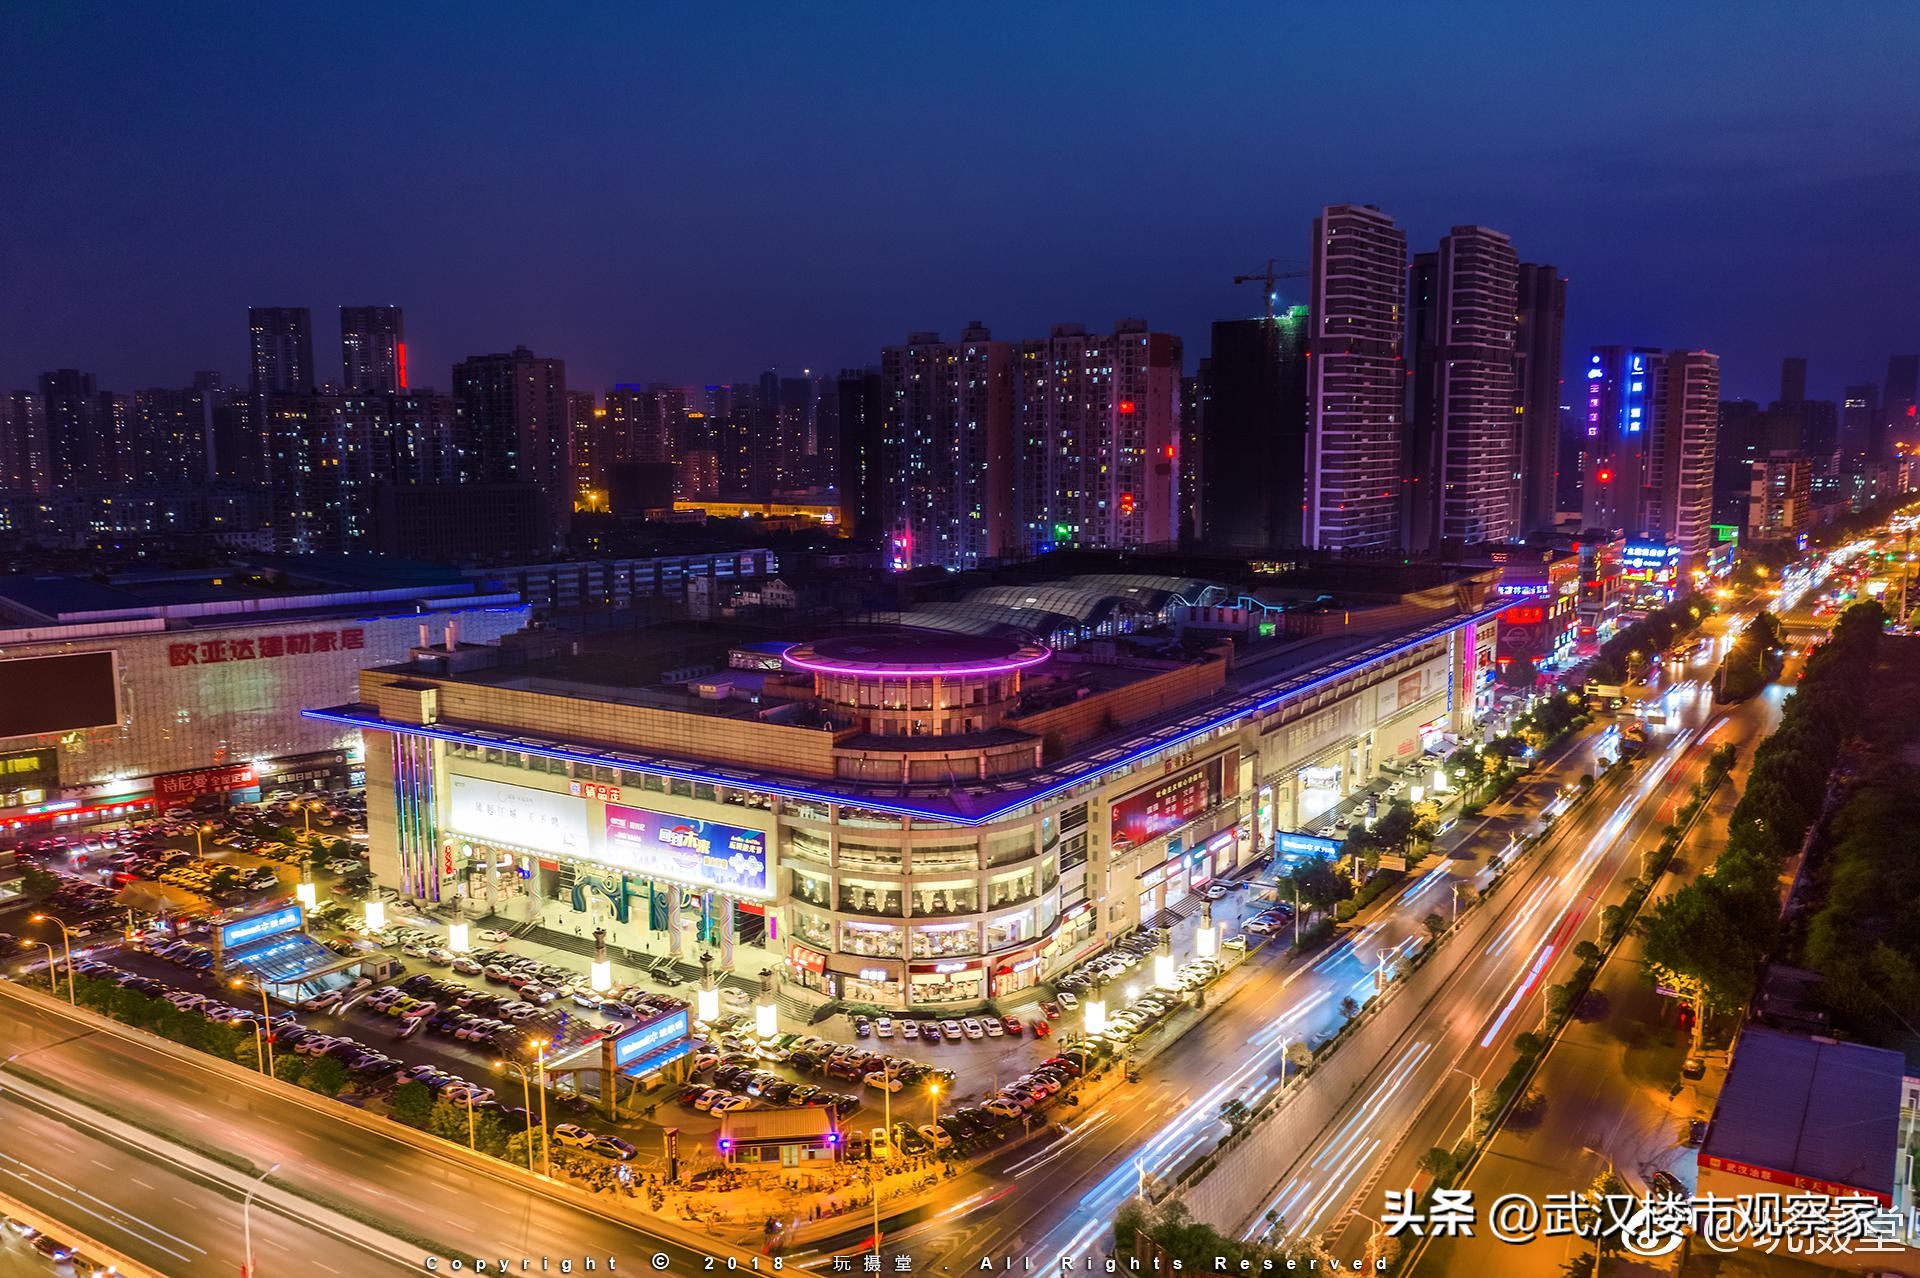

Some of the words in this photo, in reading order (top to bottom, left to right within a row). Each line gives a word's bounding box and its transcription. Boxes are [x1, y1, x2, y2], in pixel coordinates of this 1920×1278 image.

[168, 629, 365, 667] 欧亚达建材家居
[163, 774, 208, 793] 诗尼曼
[1793, 1176, 1872, 1197] 长天加
